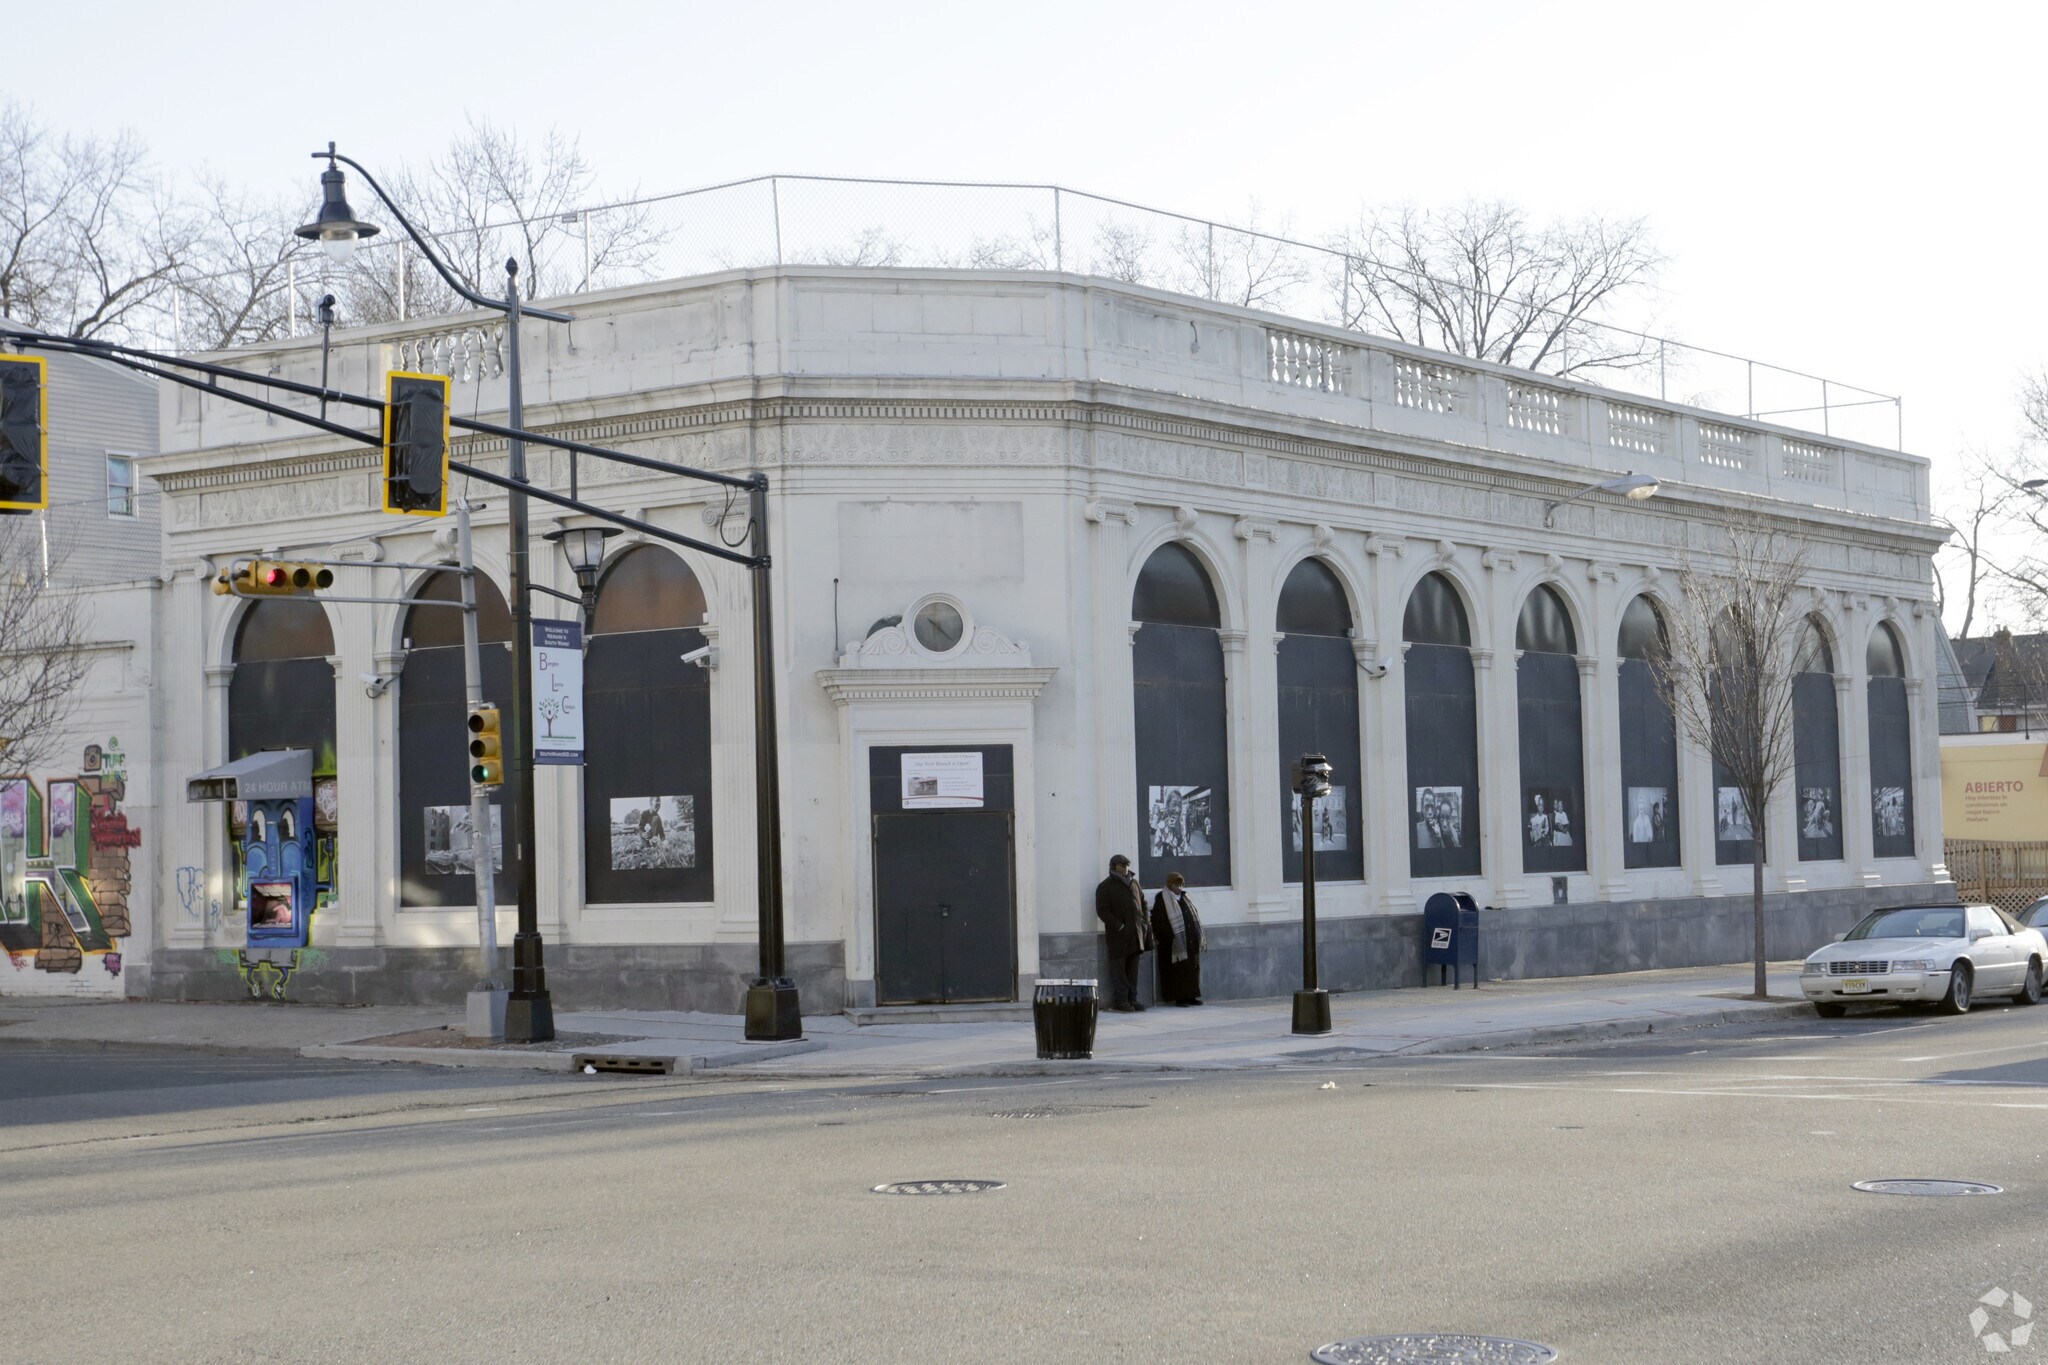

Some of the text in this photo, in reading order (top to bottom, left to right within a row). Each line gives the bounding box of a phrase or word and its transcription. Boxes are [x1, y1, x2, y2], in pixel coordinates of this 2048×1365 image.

[245, 783, 256, 793] 24
[258, 781, 288, 792] HOUR
[290, 780, 311, 792] ATM
[1965, 780, 2023, 793] ABIERTO
